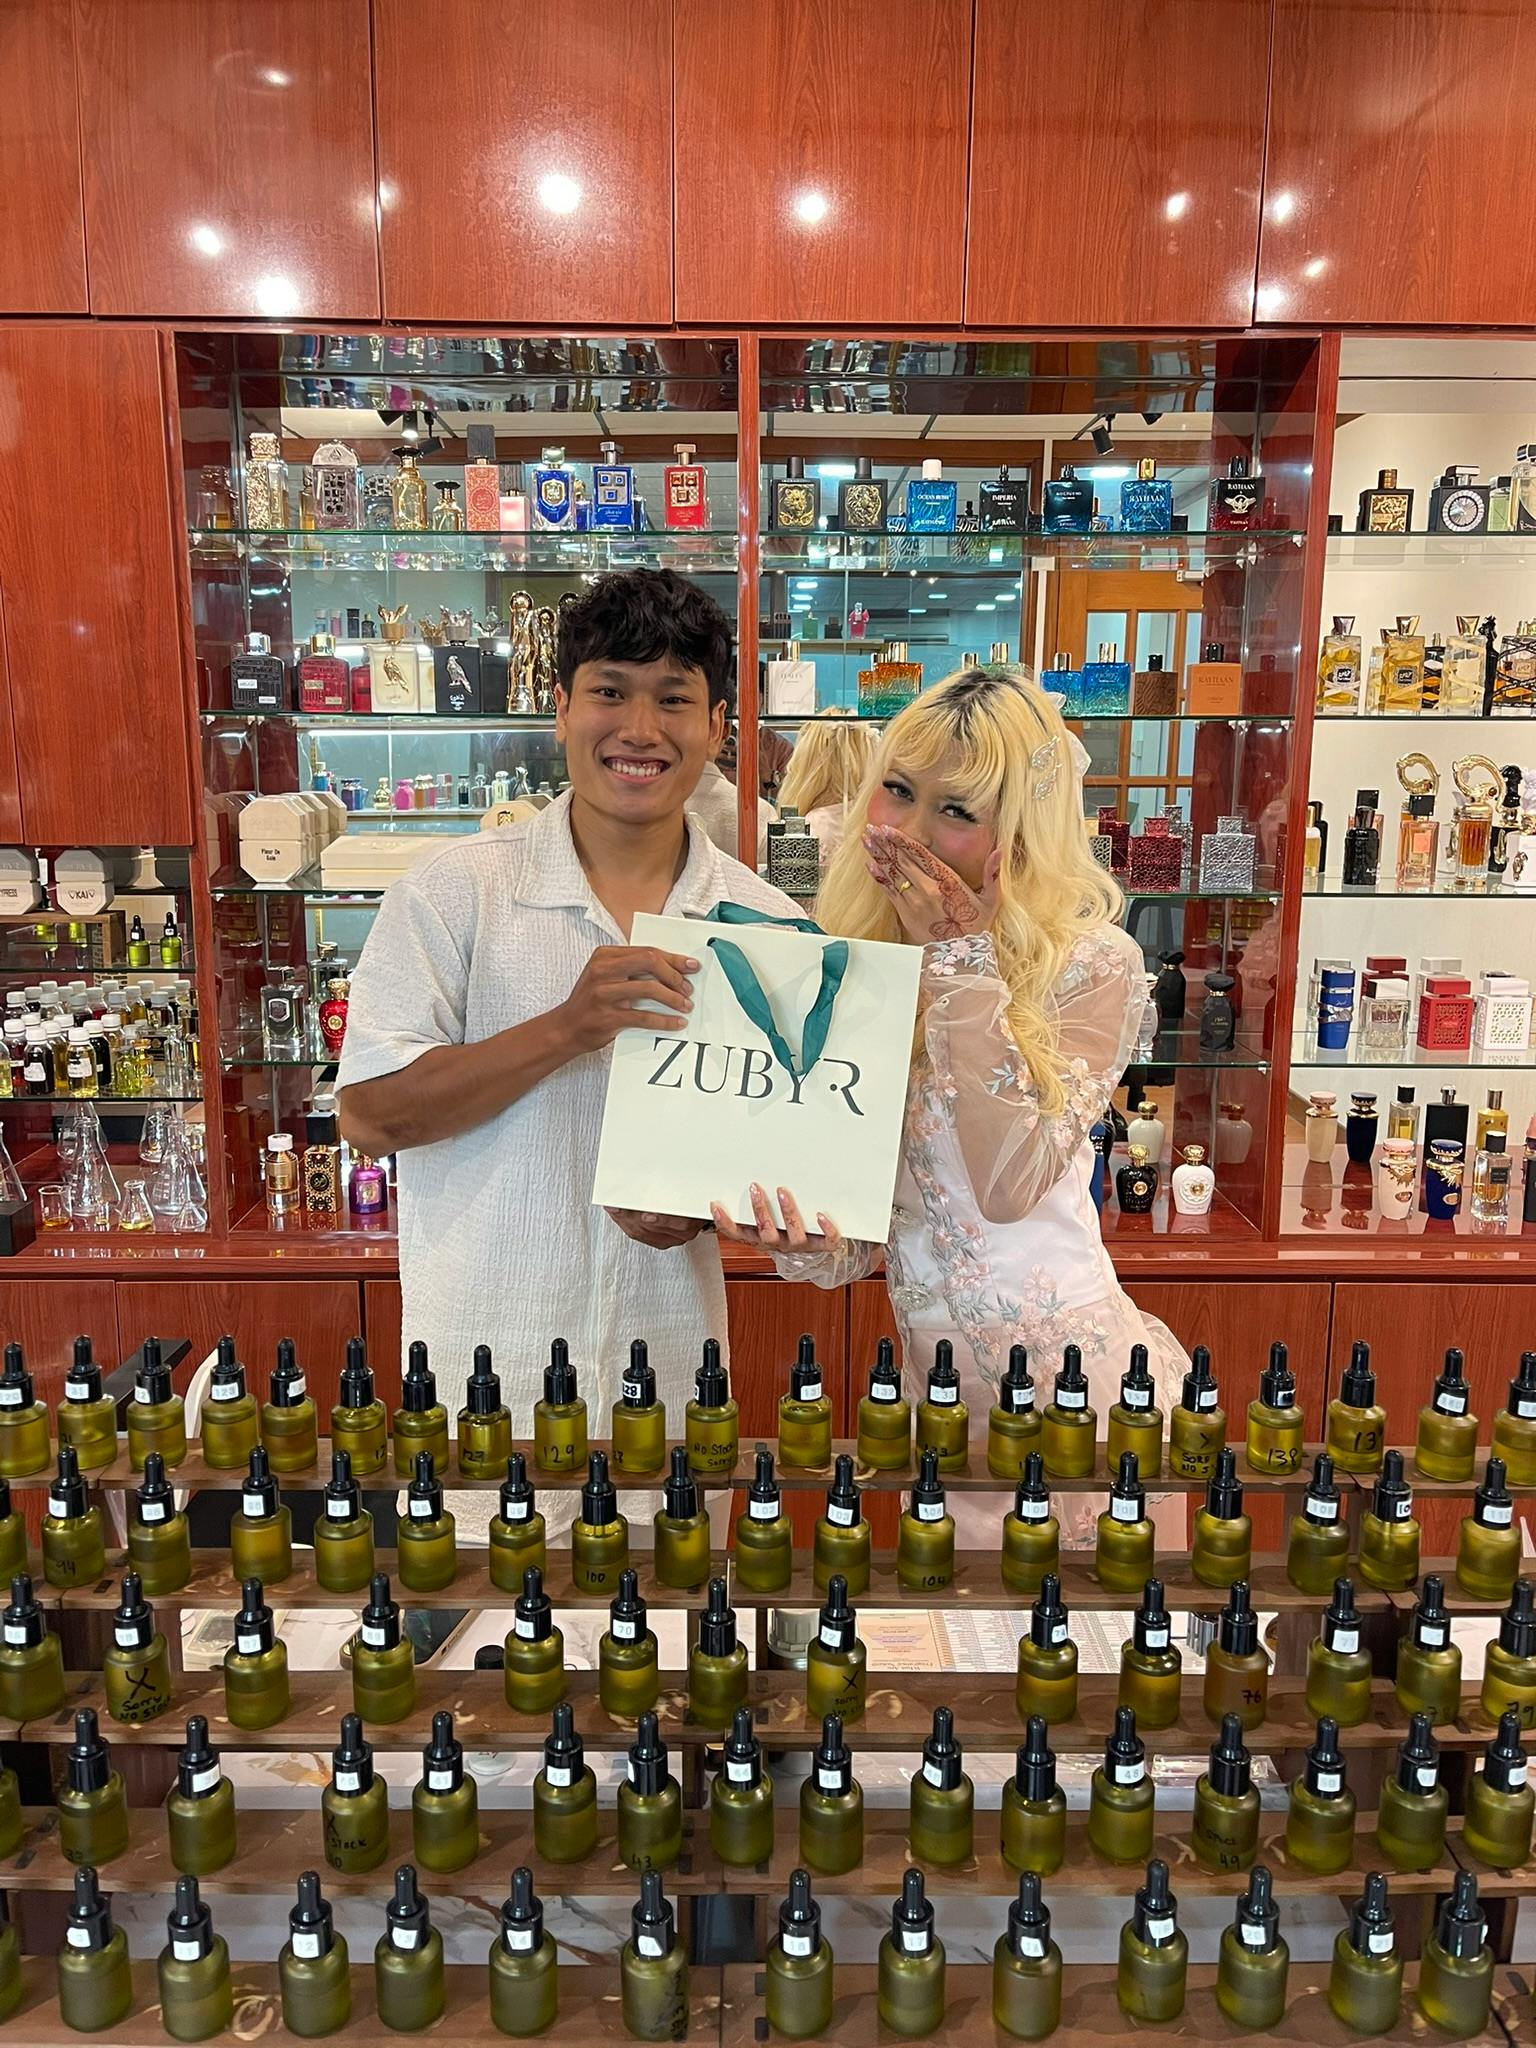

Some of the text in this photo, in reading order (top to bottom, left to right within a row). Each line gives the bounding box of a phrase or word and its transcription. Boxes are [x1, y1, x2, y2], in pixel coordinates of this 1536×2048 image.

[1227, 483, 1255, 491] RAYHAAN
[1129, 495, 1165, 503] RAYHAAN
[1198, 676, 1234, 684] RAYHAAN
[647, 1036, 865, 1116] ZUBYR
[215, 1387, 236, 1397] 123
[1354, 1431, 1378, 1452] 13
[544, 1445, 575, 1465] 129
[1268, 1448, 1298, 1467] 138
[55, 1560, 76, 1576] 94
[586, 1570, 605, 1583] 100
[618, 1625, 632, 1636] 70
[1241, 1689, 1263, 1705] 76
[1219, 1854, 1240, 1870] 49
